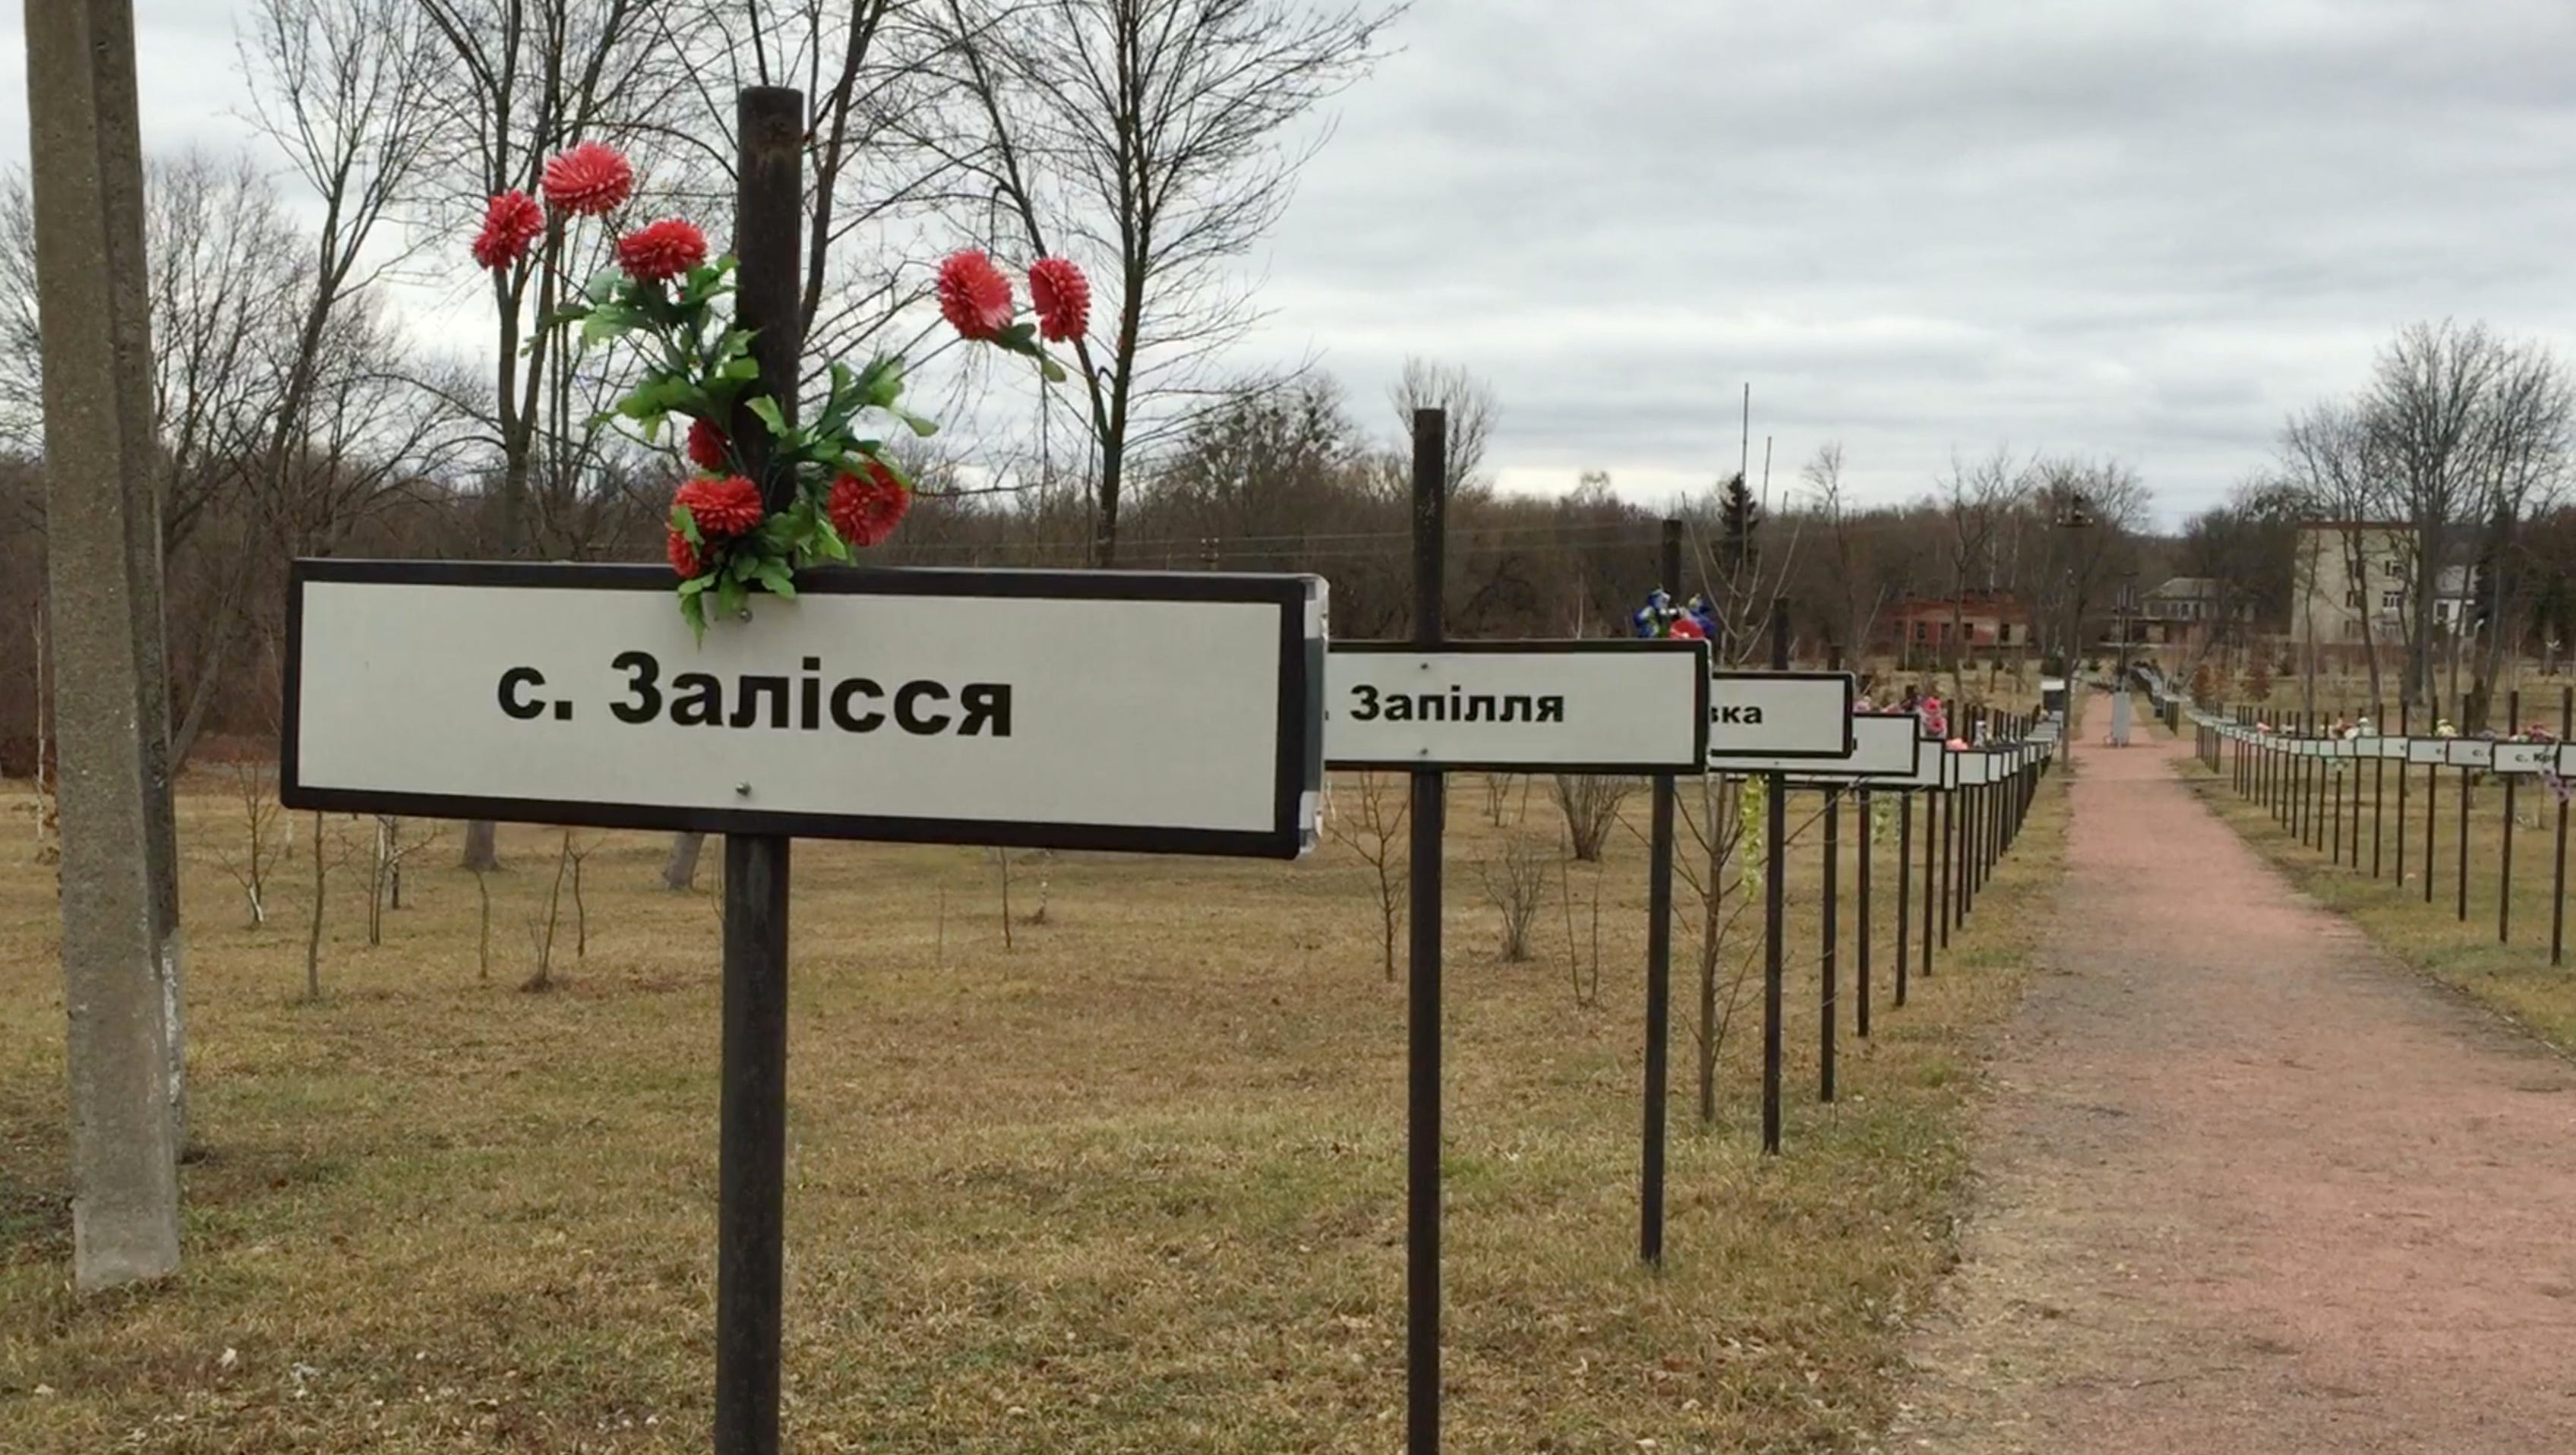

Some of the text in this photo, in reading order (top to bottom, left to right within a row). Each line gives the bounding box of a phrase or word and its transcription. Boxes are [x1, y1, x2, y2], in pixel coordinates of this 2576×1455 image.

[497, 651, 1012, 737] с. Залісся
[1350, 684, 1564, 723] Запілля
